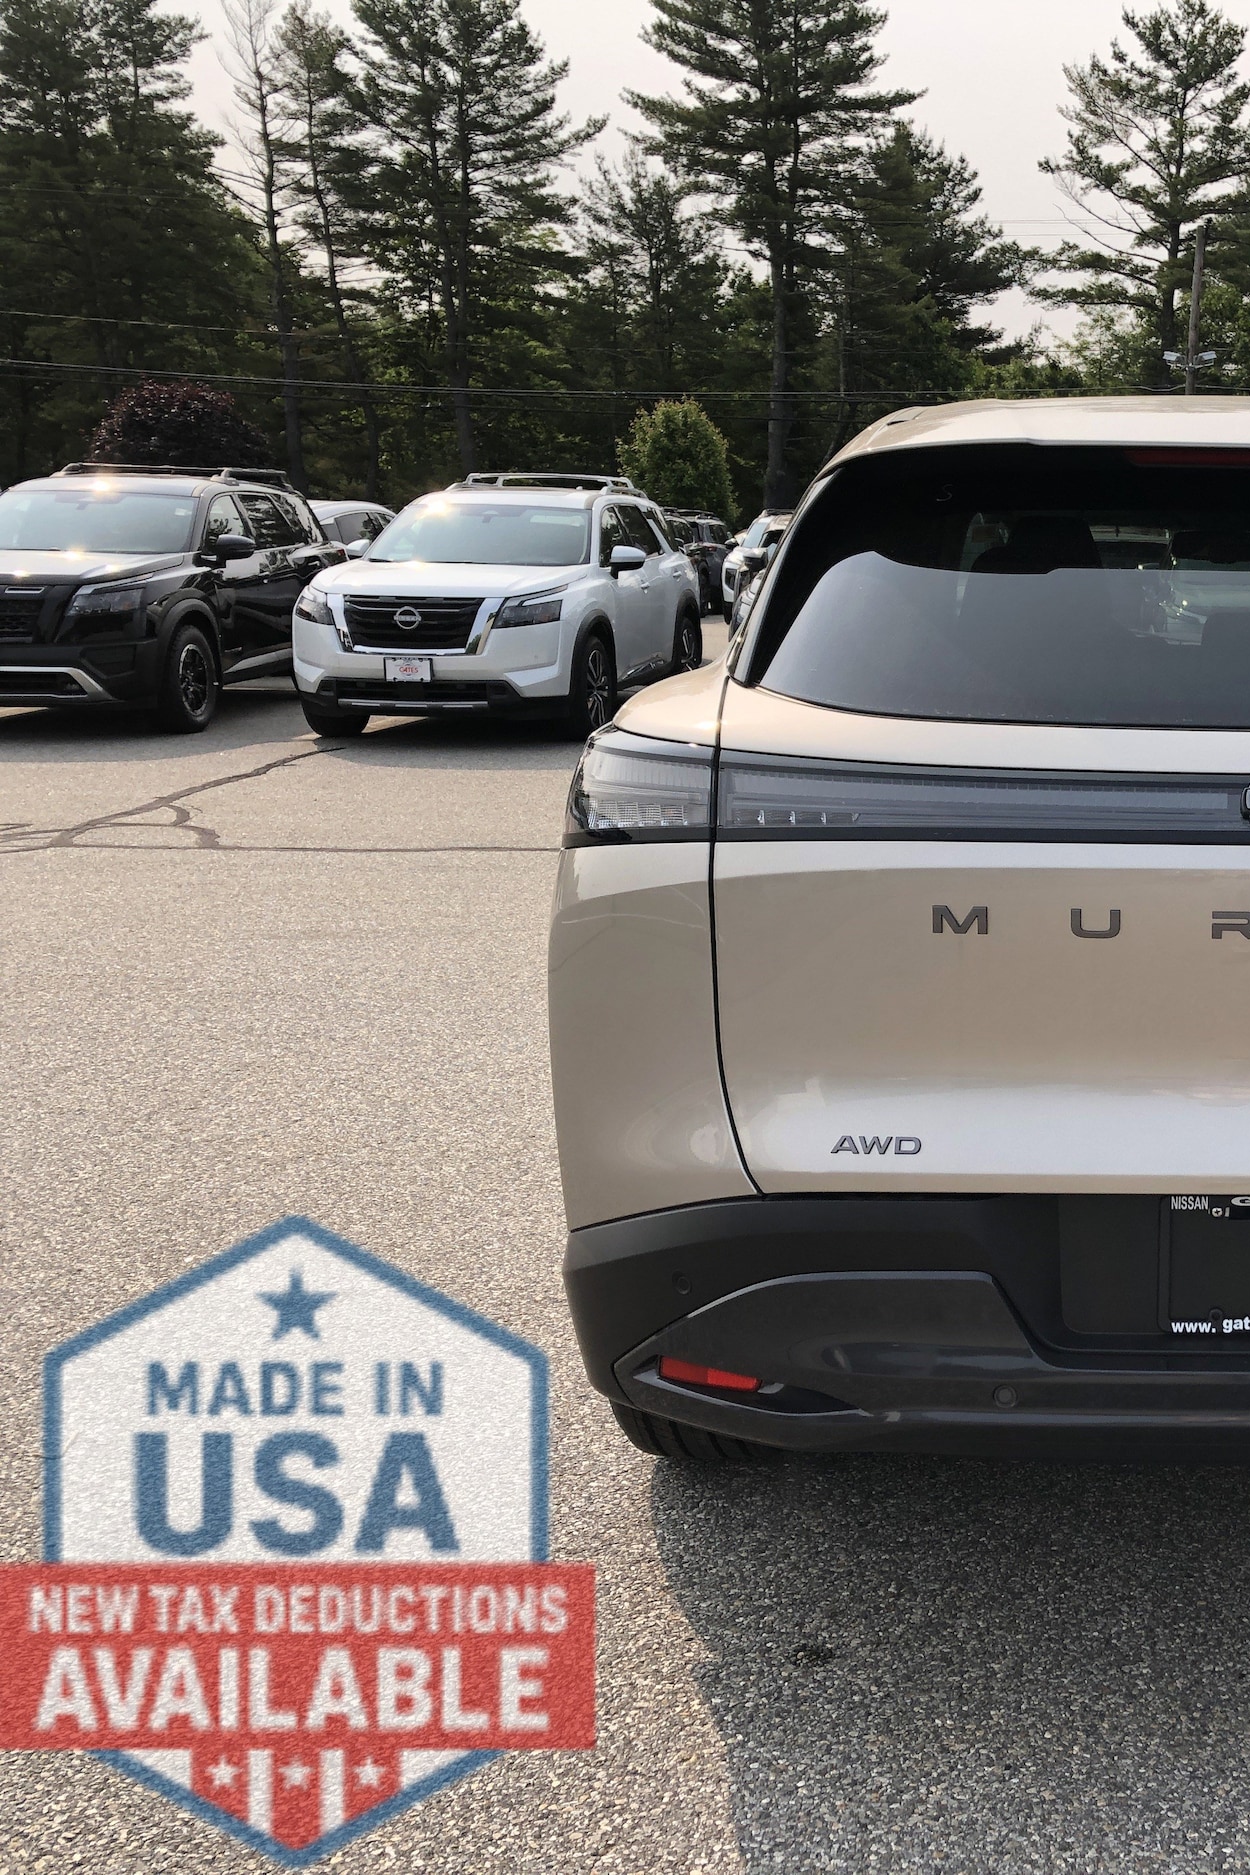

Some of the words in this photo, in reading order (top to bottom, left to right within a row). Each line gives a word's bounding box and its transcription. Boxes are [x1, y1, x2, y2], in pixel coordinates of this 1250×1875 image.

[830, 1135, 922, 1155] AWD
[1170, 1195, 1209, 1211] NISSAN
[1171, 1321, 1216, 1334] www.
